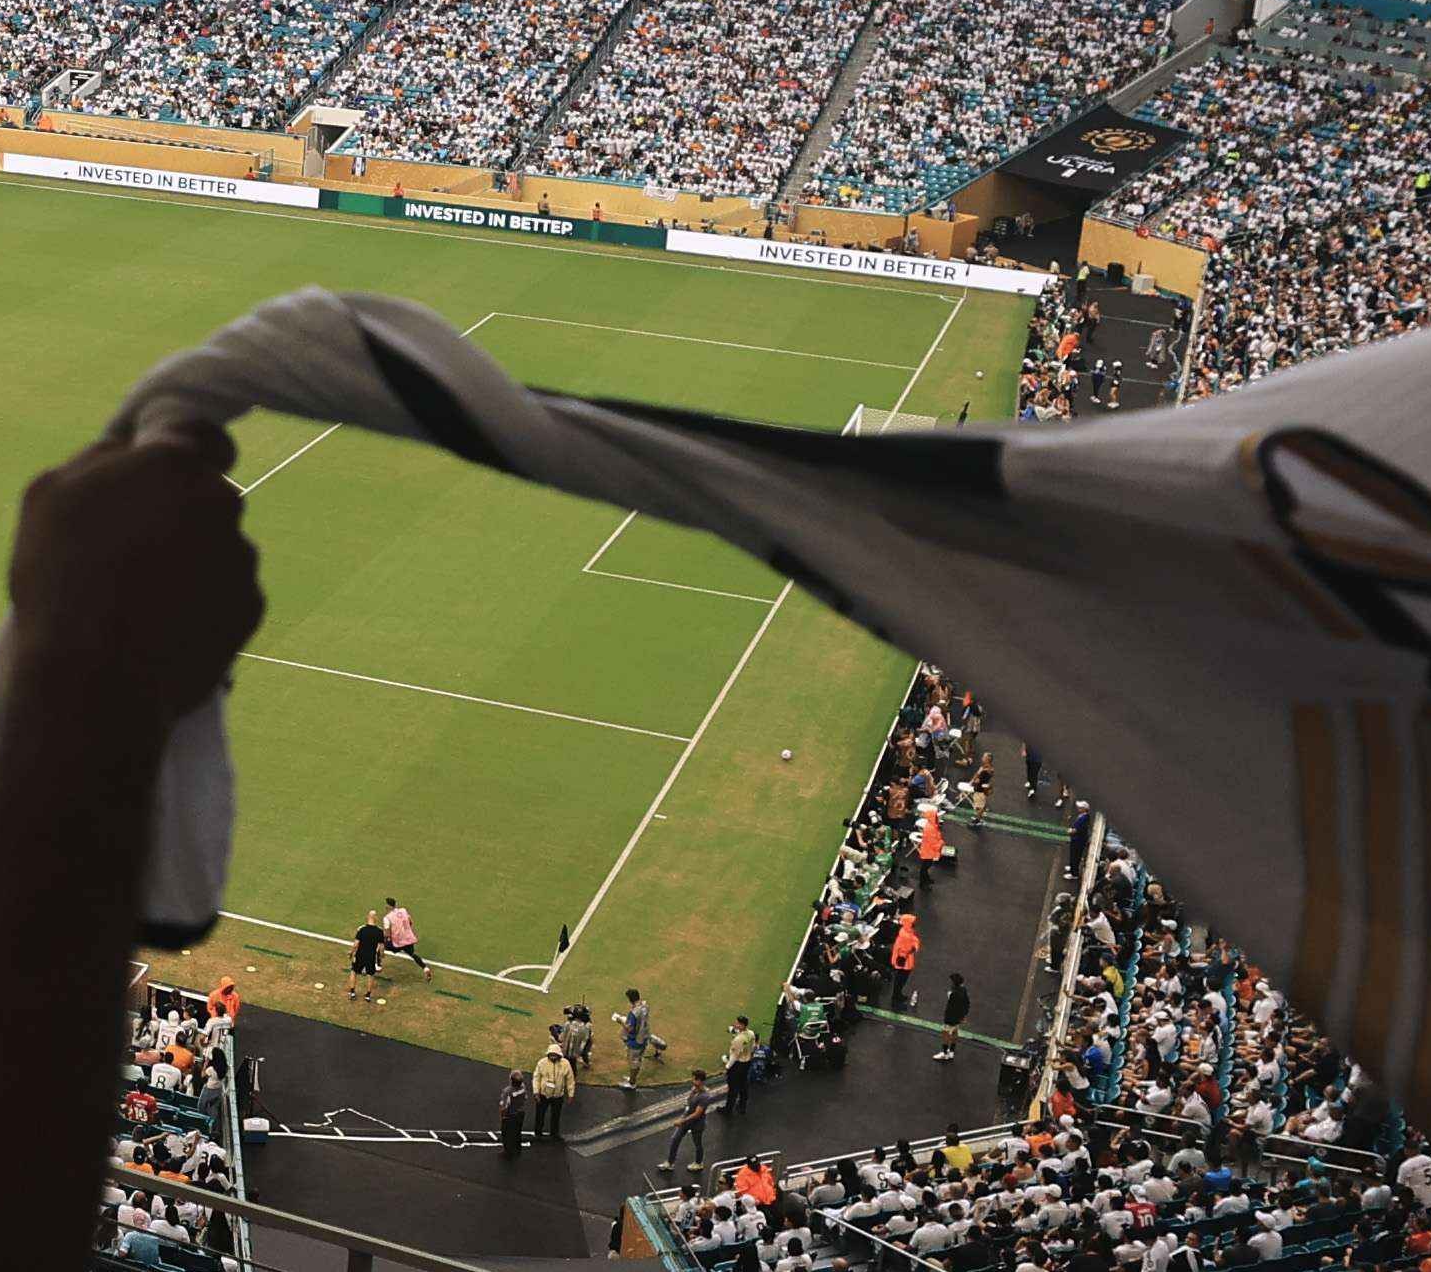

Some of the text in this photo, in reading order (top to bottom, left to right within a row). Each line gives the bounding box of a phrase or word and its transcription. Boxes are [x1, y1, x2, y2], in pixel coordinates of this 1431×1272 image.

[1046, 155, 1116, 174] ULTRA
[78, 165, 237, 196] INVESTED IN BETTER
[405, 203, 485, 226] INVESTED
[489, 212, 506, 227] IN
[759, 245, 956, 281] INVESTED IN BETTER
